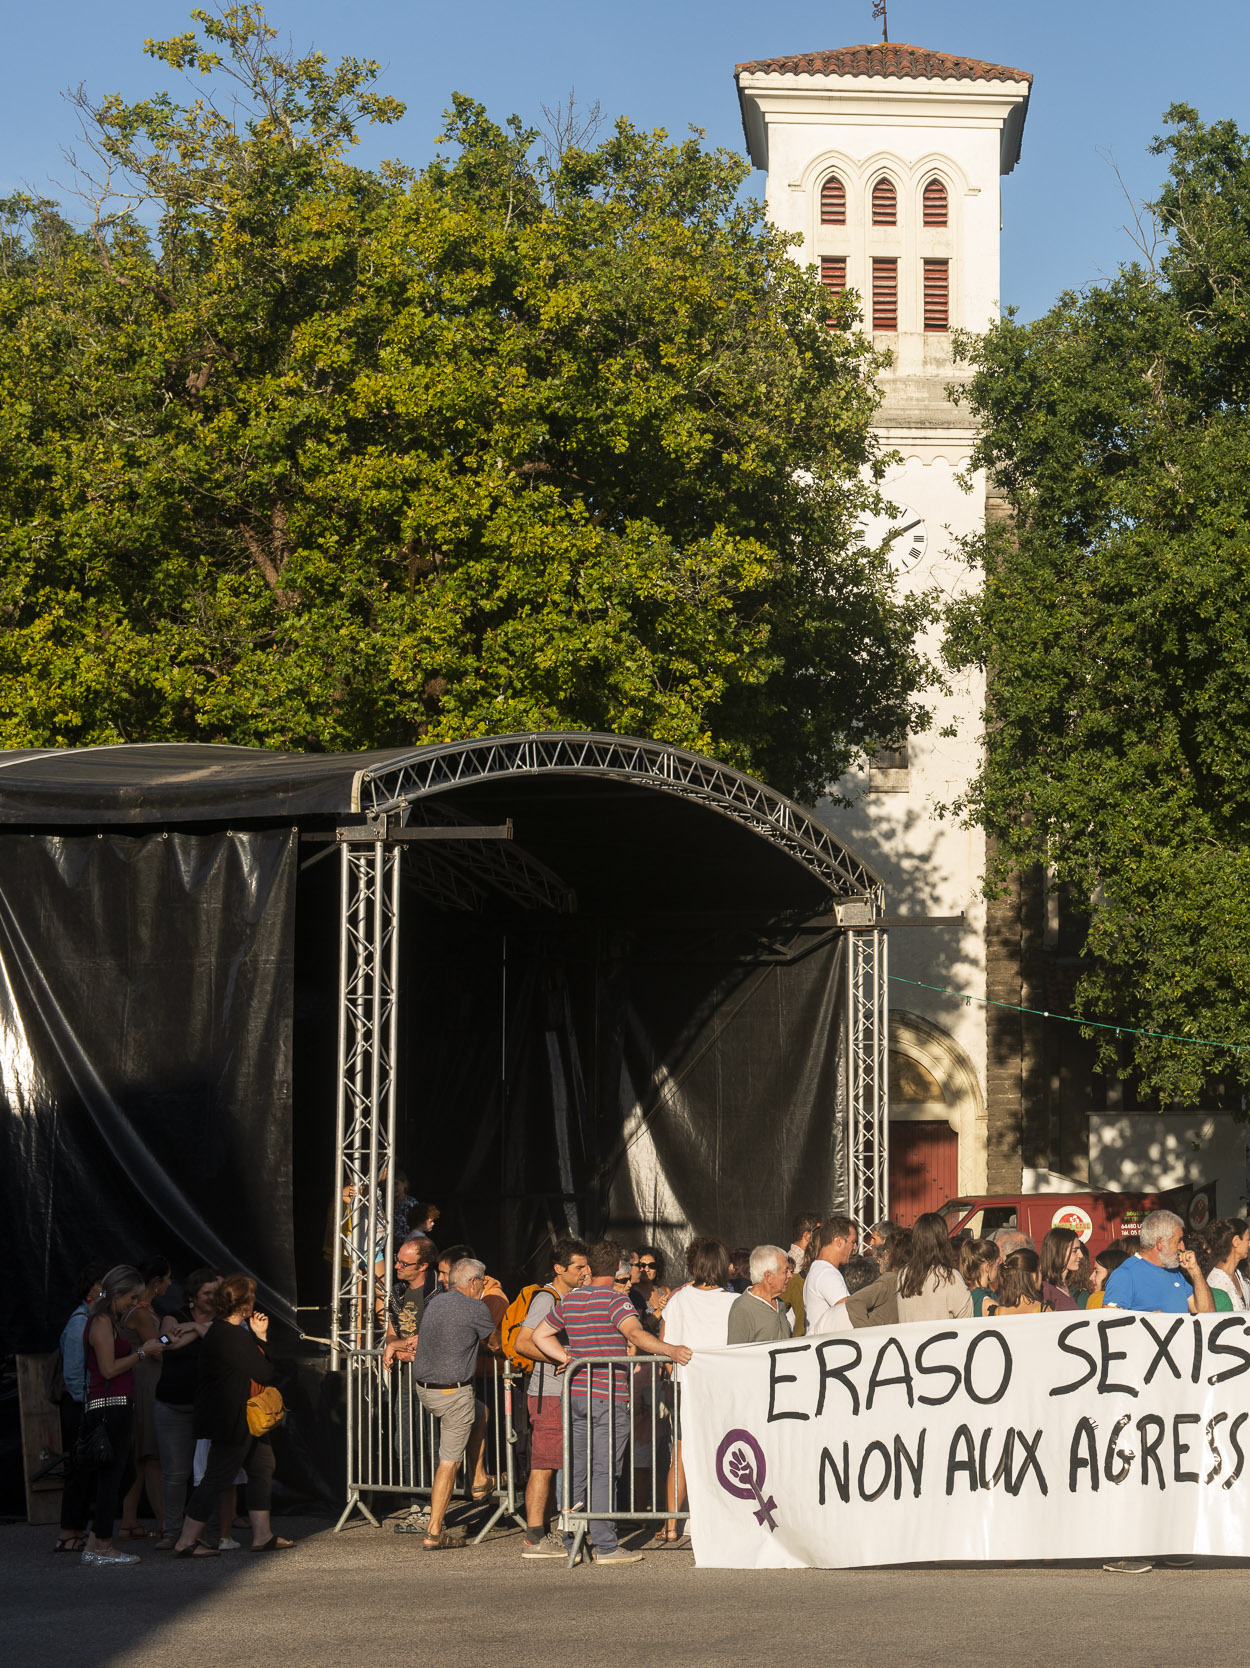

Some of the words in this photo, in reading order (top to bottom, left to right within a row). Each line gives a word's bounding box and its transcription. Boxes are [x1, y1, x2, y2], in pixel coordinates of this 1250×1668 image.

[768, 1330, 1013, 1424] ERASO
[818, 1428, 927, 1506] NON
[946, 1424, 1048, 1497] AUX
